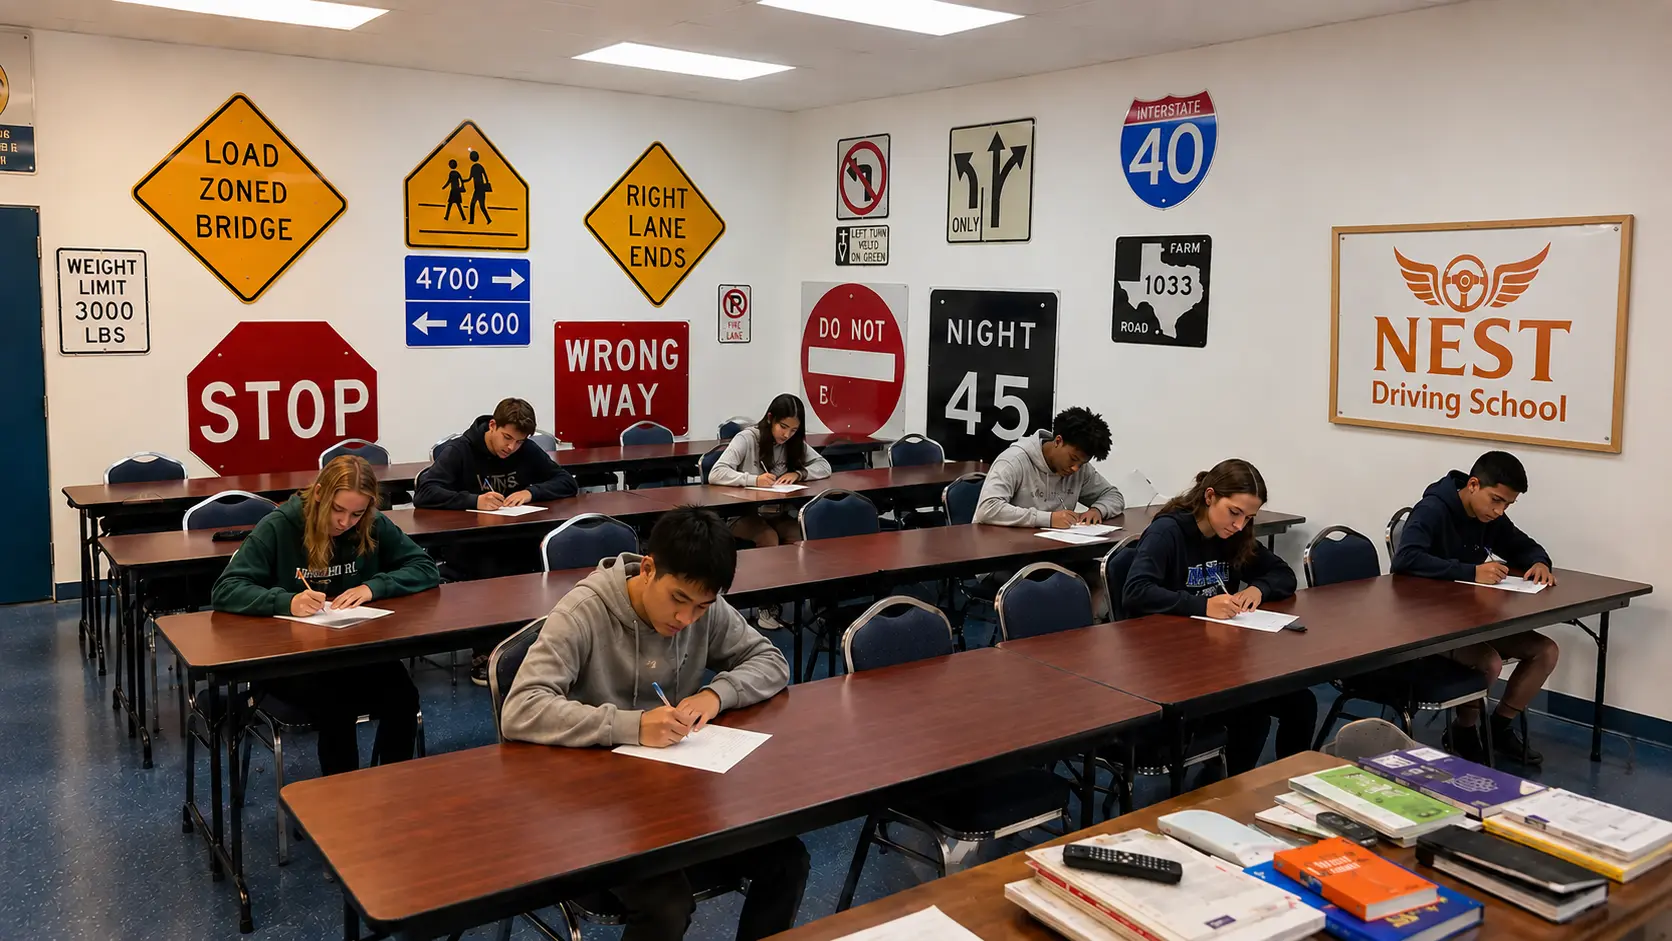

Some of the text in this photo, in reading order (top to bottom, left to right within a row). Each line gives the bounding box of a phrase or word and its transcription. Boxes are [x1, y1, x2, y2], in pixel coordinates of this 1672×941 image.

[1137, 100, 1201, 120] INTERSTATE
[205, 139, 279, 168] LOAD
[1129, 122, 1204, 185] 40
[199, 178, 287, 204] ZONED
[627, 184, 688, 209] RIGHT
[196, 214, 293, 241] BRIDGE
[629, 215, 686, 239] LANE
[952, 216, 980, 234] ONLY
[630, 246, 686, 268] ENDS
[851, 252, 886, 262] ON GREEN
[1170, 242, 1201, 254] FARM
[67, 258, 137, 276] WEIGHT
[416, 267, 479, 291] 4700
[79, 279, 127, 296] LIMIT
[1145, 275, 1193, 296] 1033
[75, 301, 134, 321] 3000
[85, 326, 126, 344] LBS
[459, 312, 520, 335] 4600
[819, 317, 885, 342] DO NOT
[947, 318, 1036, 350] NIGHT
[1120, 321, 1149, 333] ROAD
[565, 339, 680, 373] WRONG
[1373, 315, 1573, 382] NEST
[200, 379, 369, 443] STOP
[588, 382, 659, 418] WAY
[945, 370, 1030, 441] 45
[1372, 380, 1567, 422] Driving School
